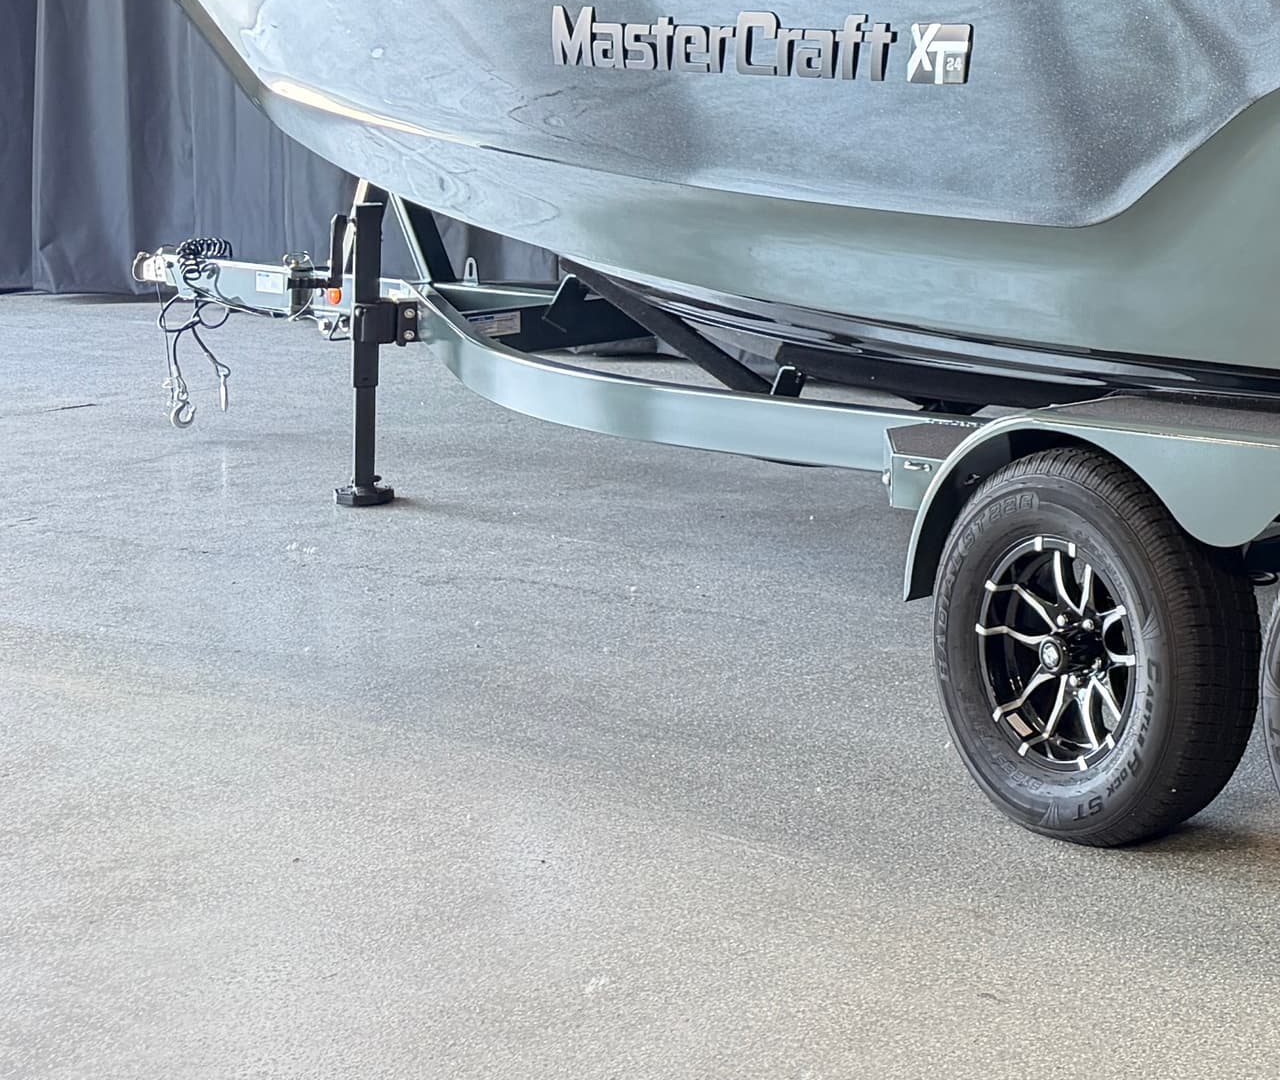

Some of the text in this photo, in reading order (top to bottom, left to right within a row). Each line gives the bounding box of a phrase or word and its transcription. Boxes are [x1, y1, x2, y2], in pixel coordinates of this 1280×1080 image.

[552, 5, 970, 85] MasterCraft XT 24
[1072, 794, 1104, 821] ST
